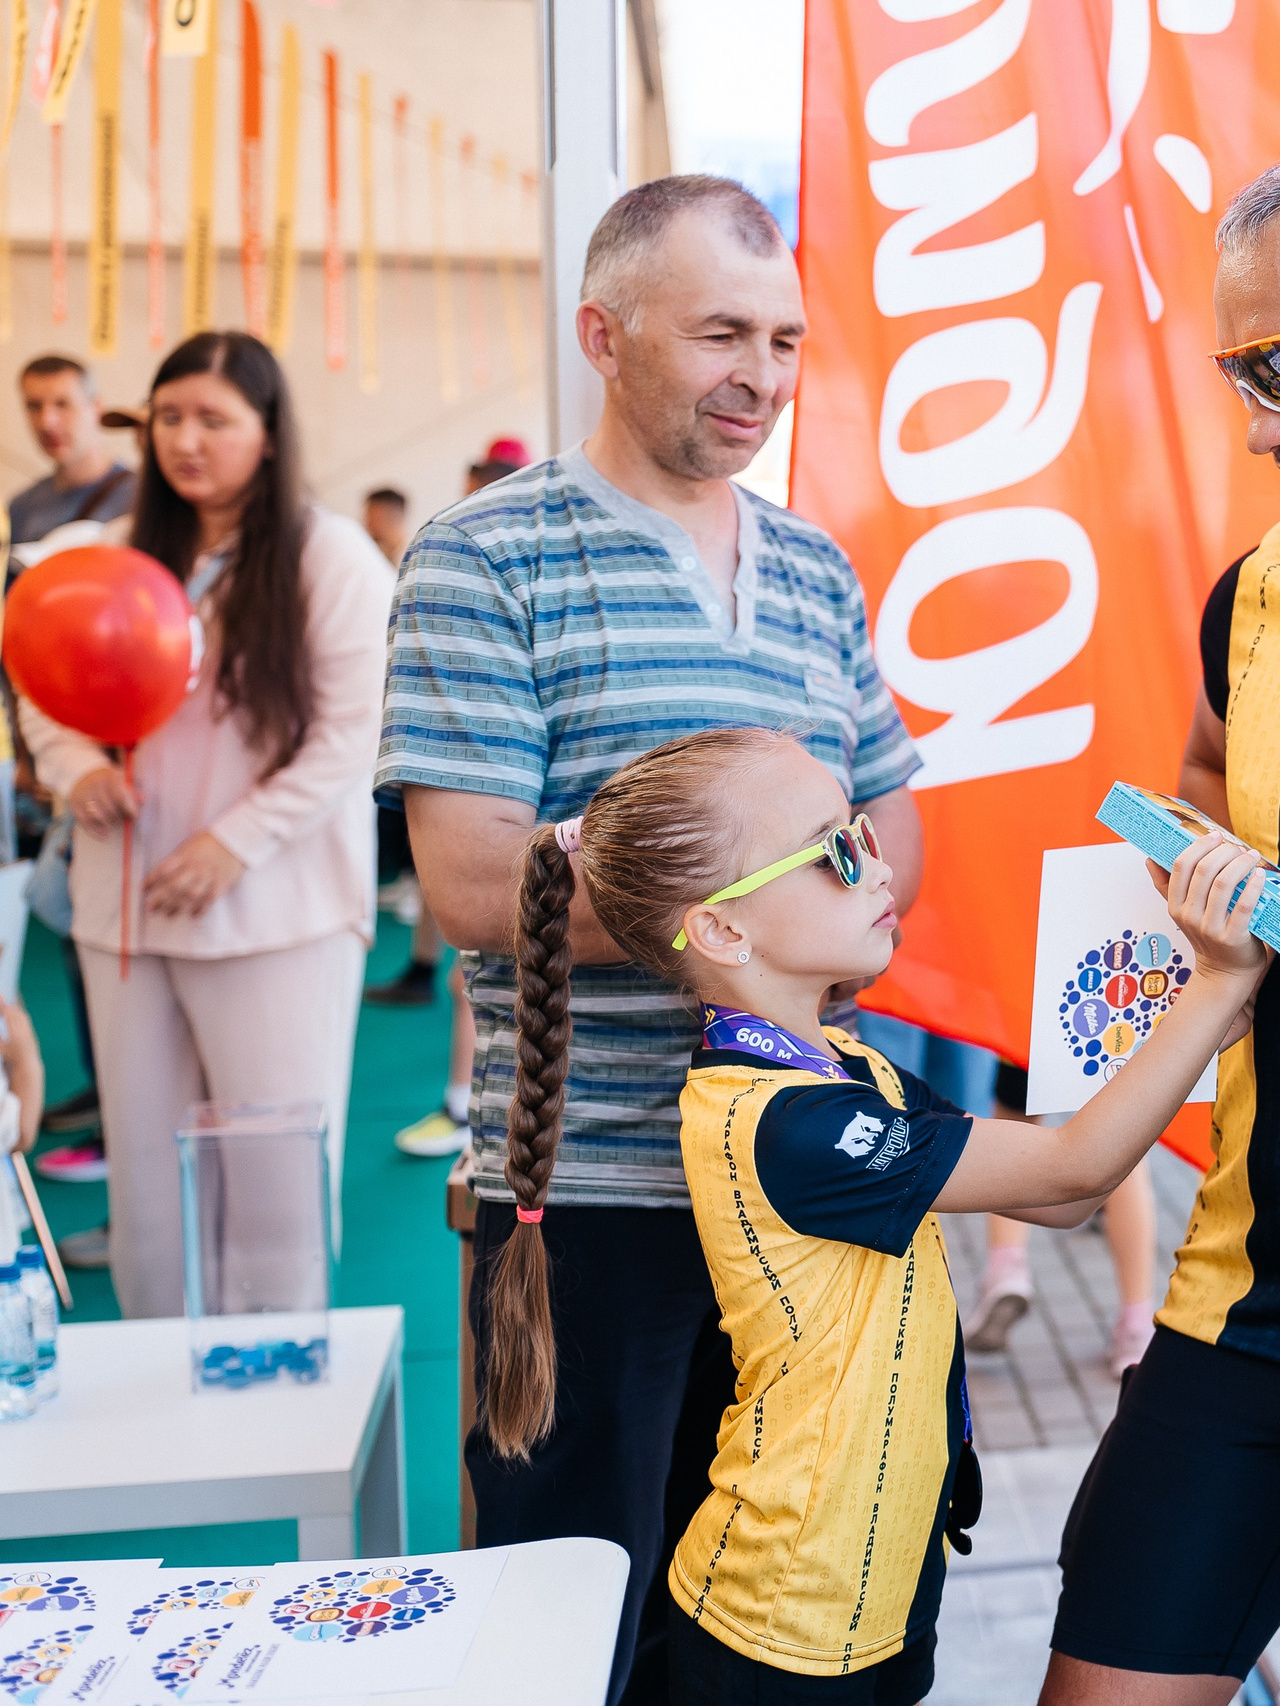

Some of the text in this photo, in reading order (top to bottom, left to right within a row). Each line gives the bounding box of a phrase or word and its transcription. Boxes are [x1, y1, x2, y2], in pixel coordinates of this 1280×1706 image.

[736, 1027, 775, 1053] 600
[1083, 1002, 1098, 1036] Milka
[876, 1372, 900, 1494] ПОЛУМАРАФОН
[848, 1502, 880, 1632] ВЛАДИМИРСКИЙ
